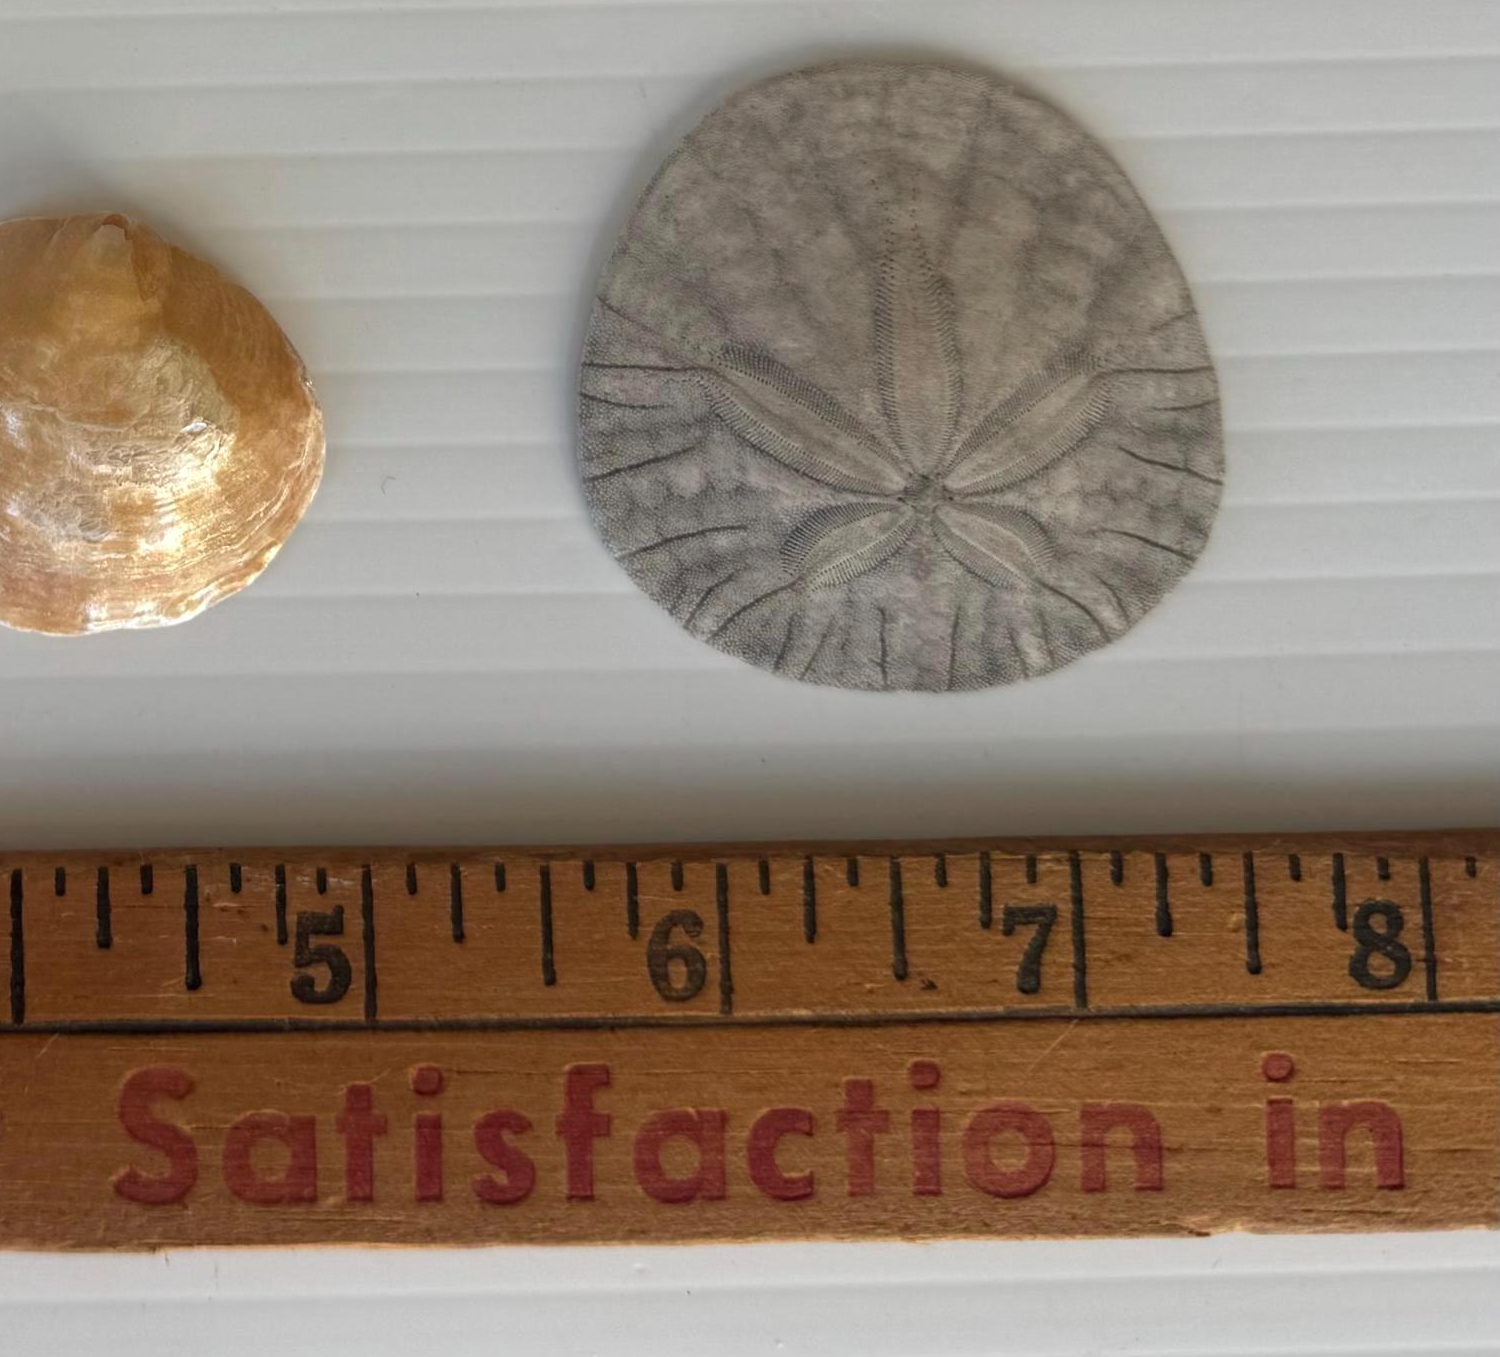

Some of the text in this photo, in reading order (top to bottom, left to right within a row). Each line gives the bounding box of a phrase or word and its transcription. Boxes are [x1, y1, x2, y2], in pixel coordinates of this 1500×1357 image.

[290, 905, 353, 1005] 5
[646, 910, 707, 1003] 6
[1001, 904, 1058, 995] 7
[1348, 899, 1413, 991] 8
[113, 1058, 1164, 1207] Satisfaction
[1262, 1052, 1405, 1191] in
